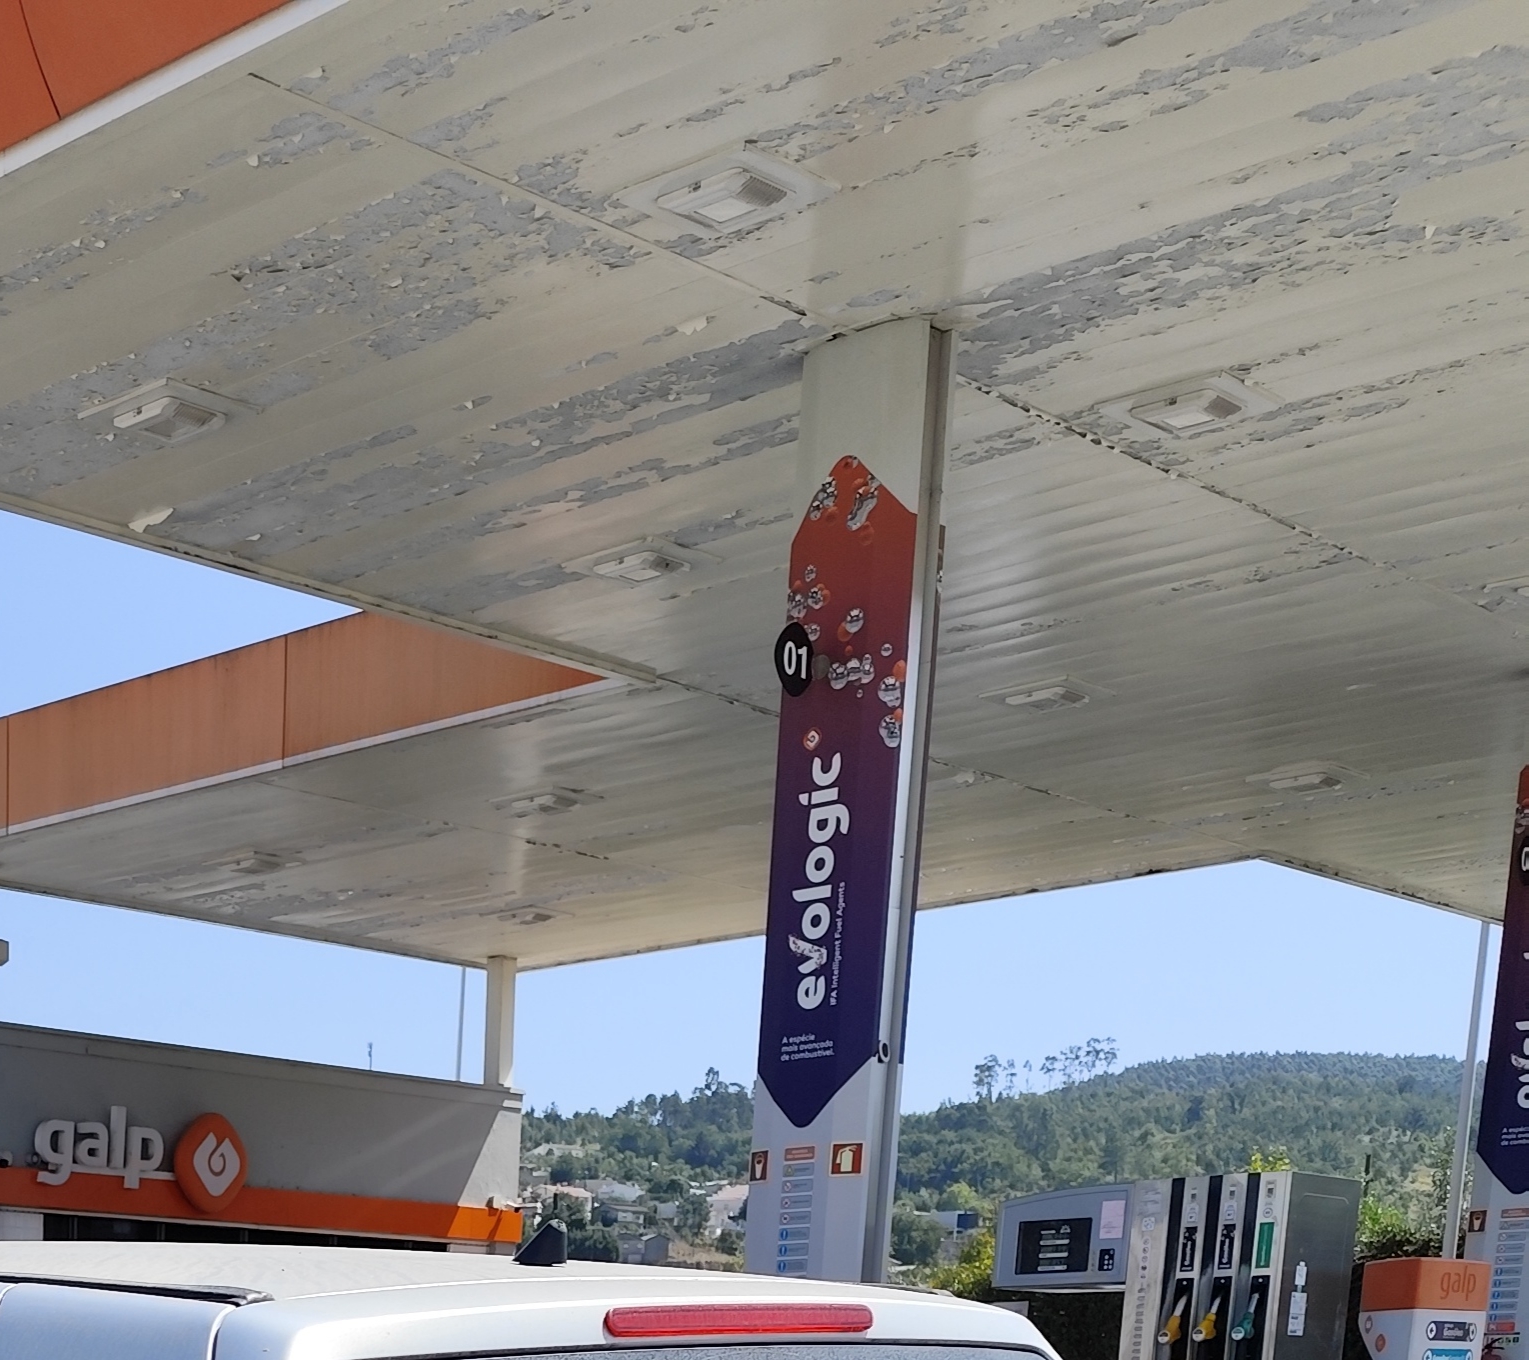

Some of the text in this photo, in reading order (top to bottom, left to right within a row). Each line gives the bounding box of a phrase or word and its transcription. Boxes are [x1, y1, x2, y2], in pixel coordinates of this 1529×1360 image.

[783, 641, 808, 679] 01
[789, 752, 850, 1010] evologic
[836, 881, 846, 916] Agents
[834, 917, 843, 938] Fuel
[831, 939, 843, 989] Intelligent
[781, 1036, 789, 1044] A
[35, 1105, 165, 1190] galp
[1440, 1265, 1477, 1301] galp
